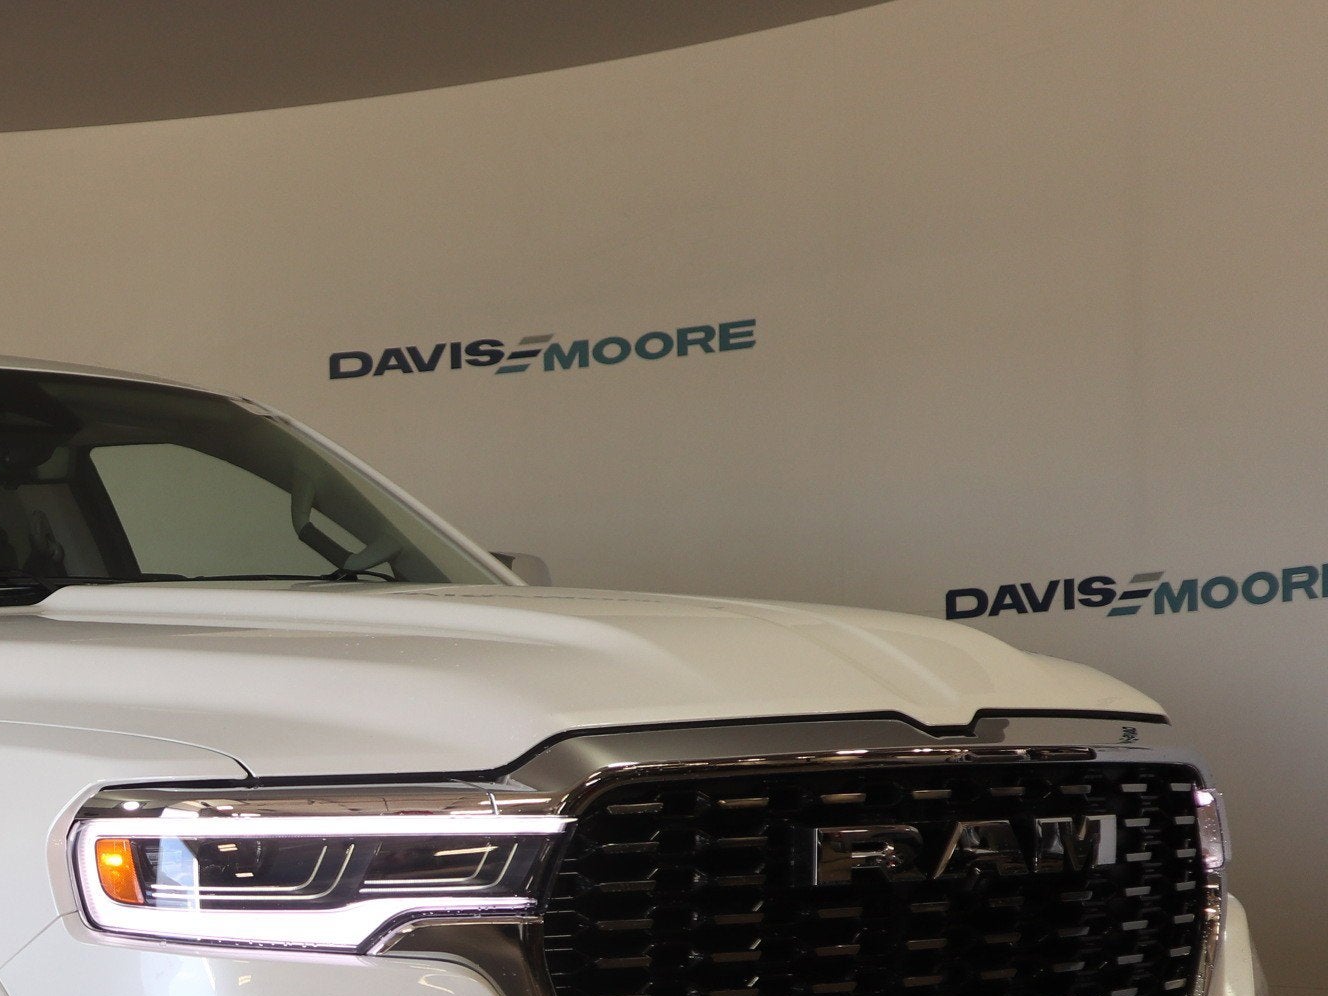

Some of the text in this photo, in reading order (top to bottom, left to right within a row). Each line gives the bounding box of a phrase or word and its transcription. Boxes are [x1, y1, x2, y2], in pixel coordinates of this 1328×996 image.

[329, 318, 757, 380] DAVIS MOORE
[945, 564, 1328, 620] DAVIS MOOR
[812, 814, 1117, 887] RAM
